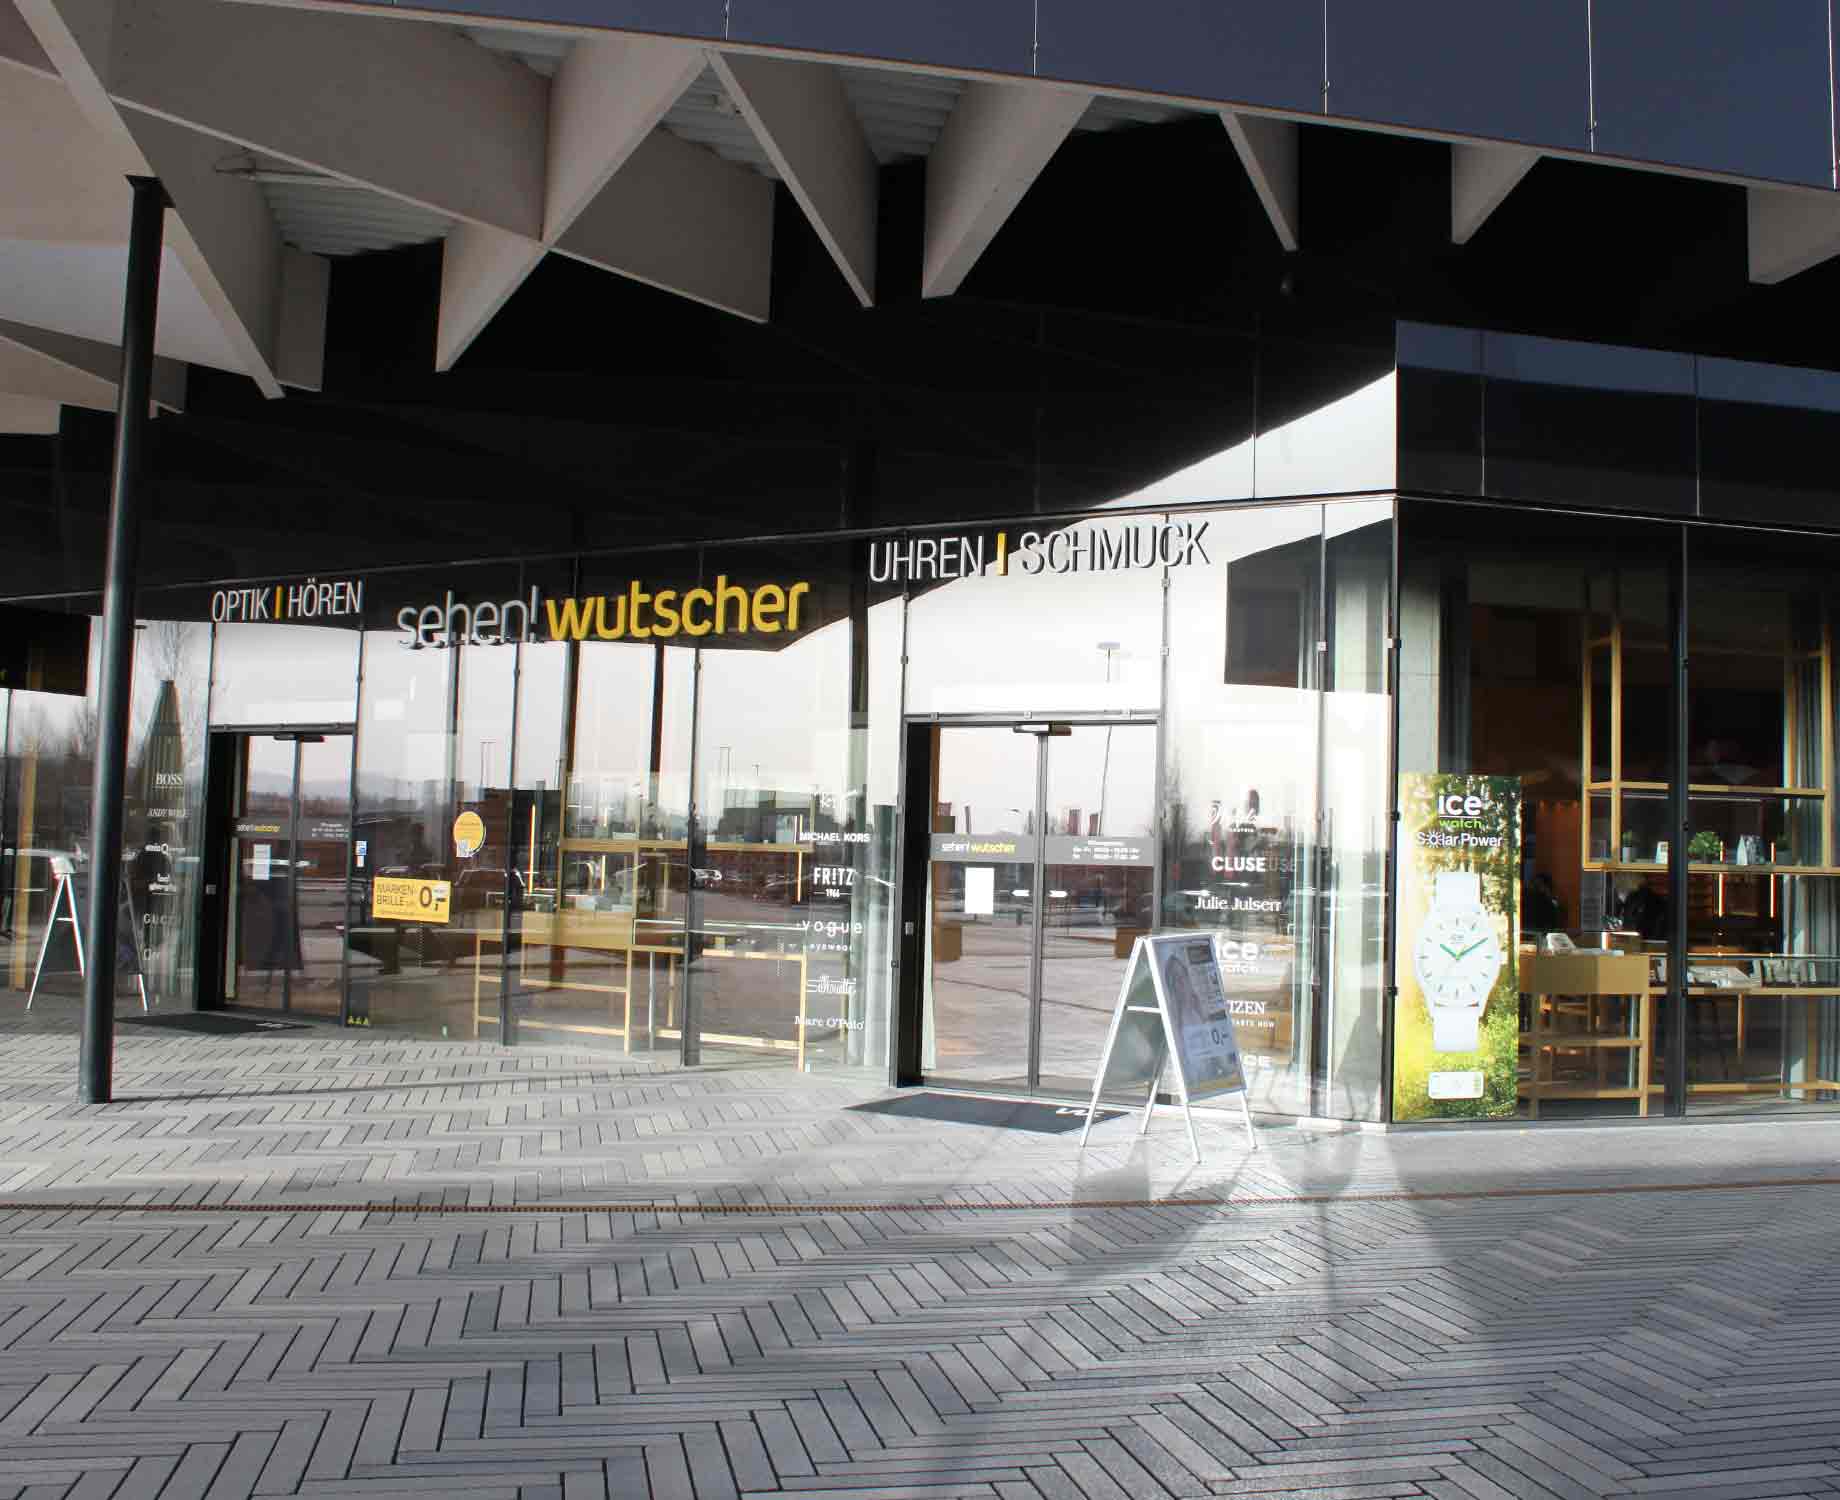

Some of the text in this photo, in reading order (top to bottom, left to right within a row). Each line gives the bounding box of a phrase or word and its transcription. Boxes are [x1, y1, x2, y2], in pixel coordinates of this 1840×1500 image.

[869, 536, 987, 583] UHREN
[1019, 520, 1212, 576] SCHMUCK
[212, 586, 270, 622] OPTIK
[287, 578, 362, 617] HÖREN
[396, 575, 809, 648] sehen! wutscher
[156, 772, 183, 785] BOSS
[1438, 788, 1482, 816] ice
[799, 831, 871, 843] MICHAEL KORS
[1460, 832, 1503, 847] Power
[1212, 856, 1265, 872] CLUSE
[813, 867, 856, 886] FR!TZ
[1194, 896, 1228, 910] Julie
[801, 919, 863, 937] vogue
